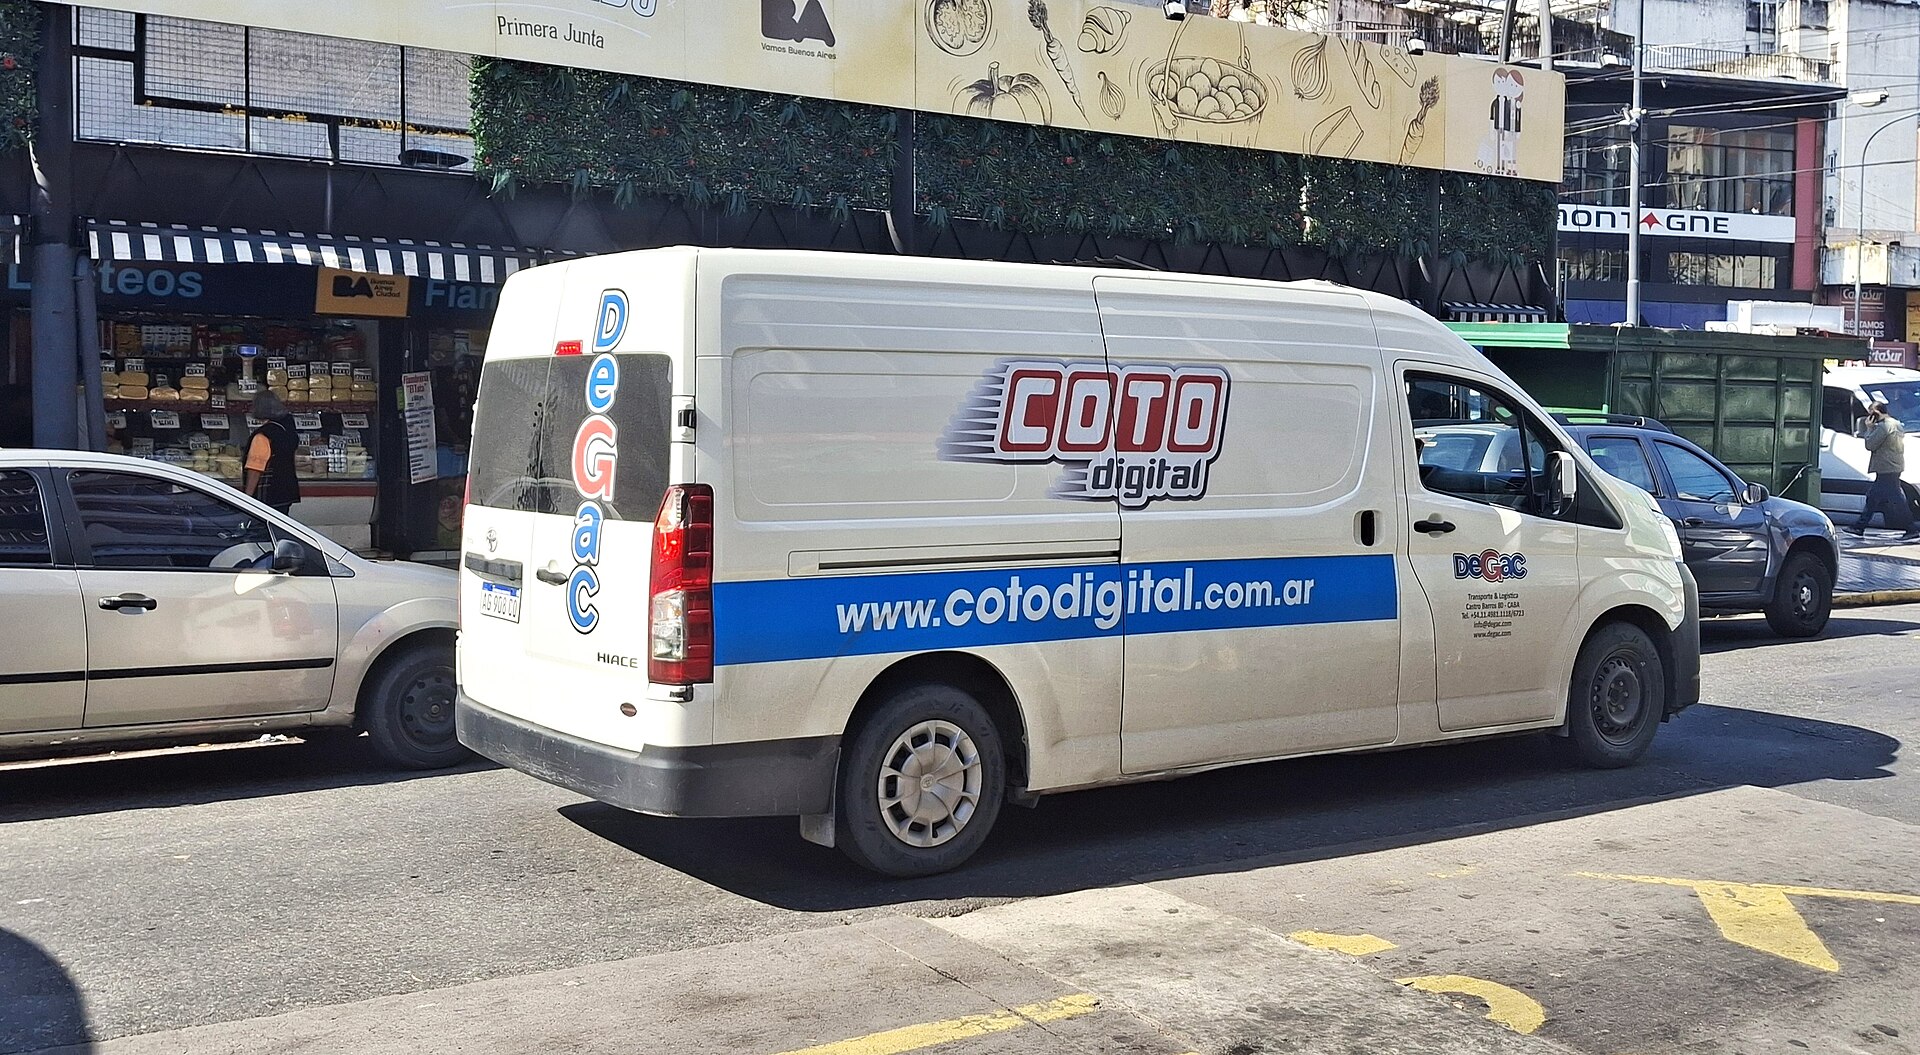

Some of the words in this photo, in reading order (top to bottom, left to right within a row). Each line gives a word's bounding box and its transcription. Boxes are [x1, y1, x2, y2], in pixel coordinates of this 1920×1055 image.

[497, 16, 558, 40] Primera
[563, 24, 604, 49] Junta
[761, 42, 787, 53] Vamos
[788, 46, 815, 57] Buenos
[817, 51, 837, 60] Aires
[8, 260, 202, 298] Lteos
[332, 276, 374, 299] BA
[376, 290, 400, 298] Ciudad
[1843, 288, 1882, 301] CaaSur
[1844, 319, 1885, 329] RÉTAMOS
[1002, 371, 1221, 450] COTO
[1091, 458, 1202, 499] digital
[482, 592, 493, 611] AG
[493, 595, 507, 615] 908
[836, 567, 1316, 633] www.cotodigital.com.ar
[1468, 593, 1493, 601] Transporte
[597, 652, 639, 669] HIACE
